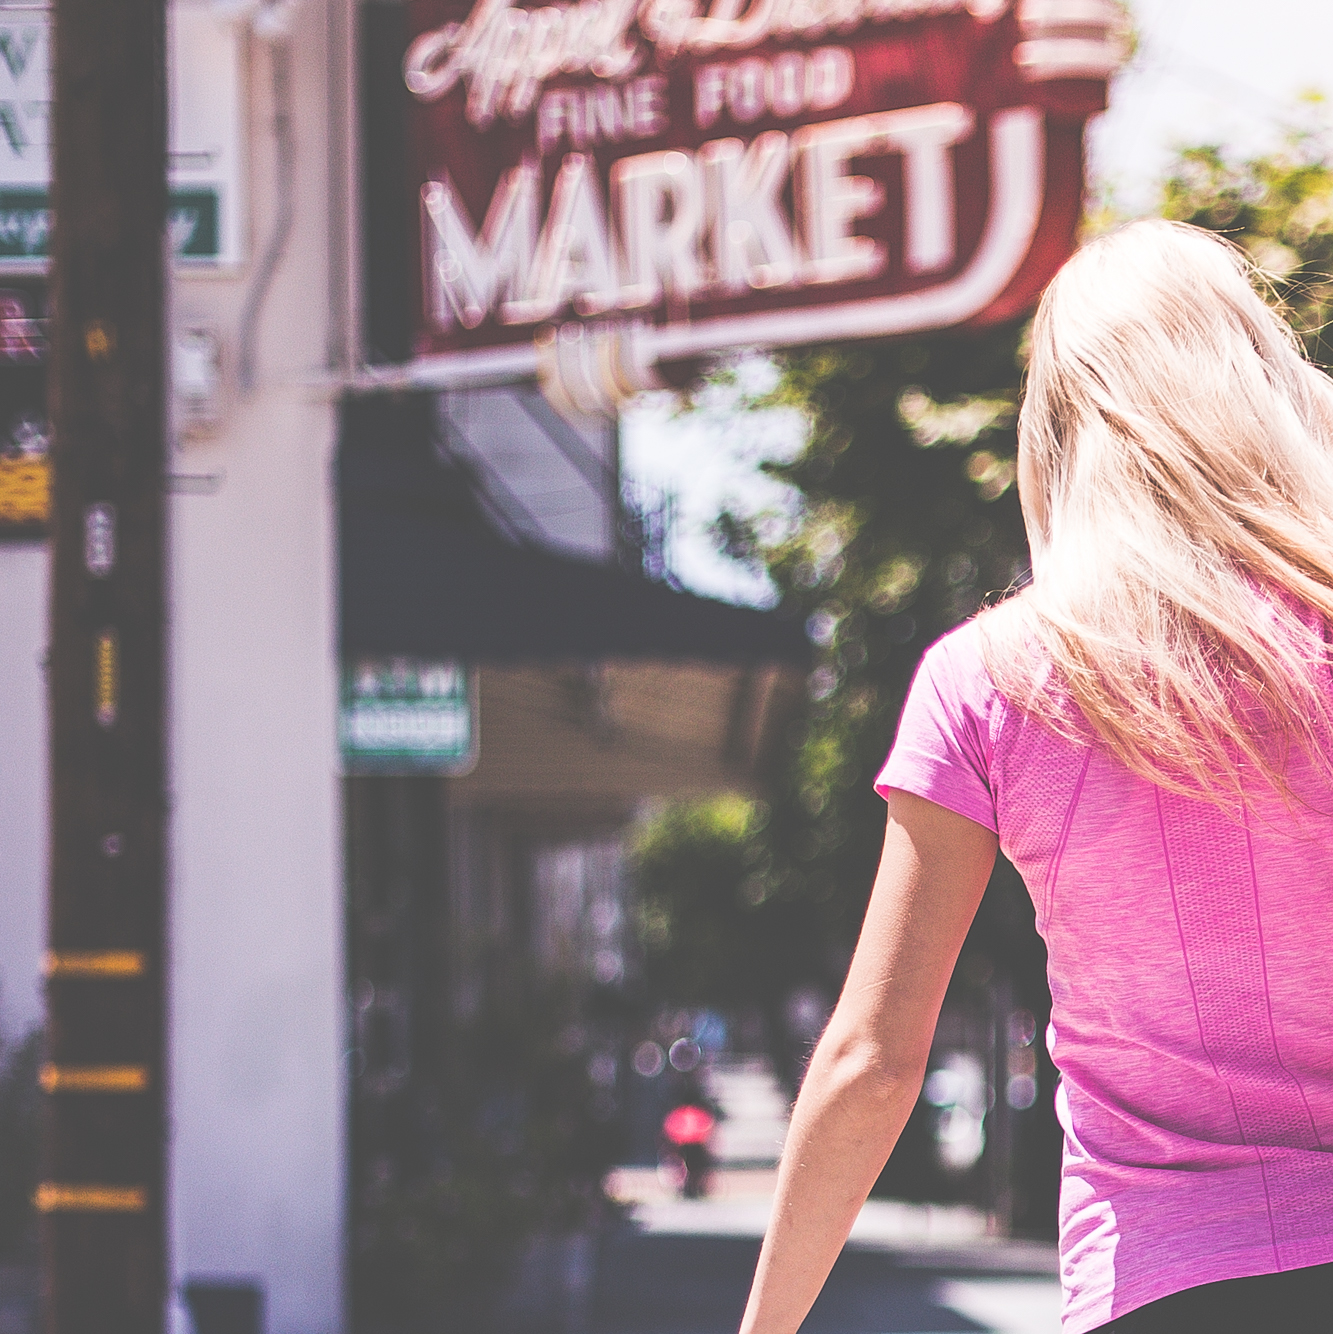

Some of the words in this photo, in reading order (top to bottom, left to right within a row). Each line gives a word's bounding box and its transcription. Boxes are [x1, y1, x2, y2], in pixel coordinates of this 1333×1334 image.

[538, 75, 667, 152] FINE
[698, 46, 853, 126] FOOD
[420, 101, 974, 330] MARKET
